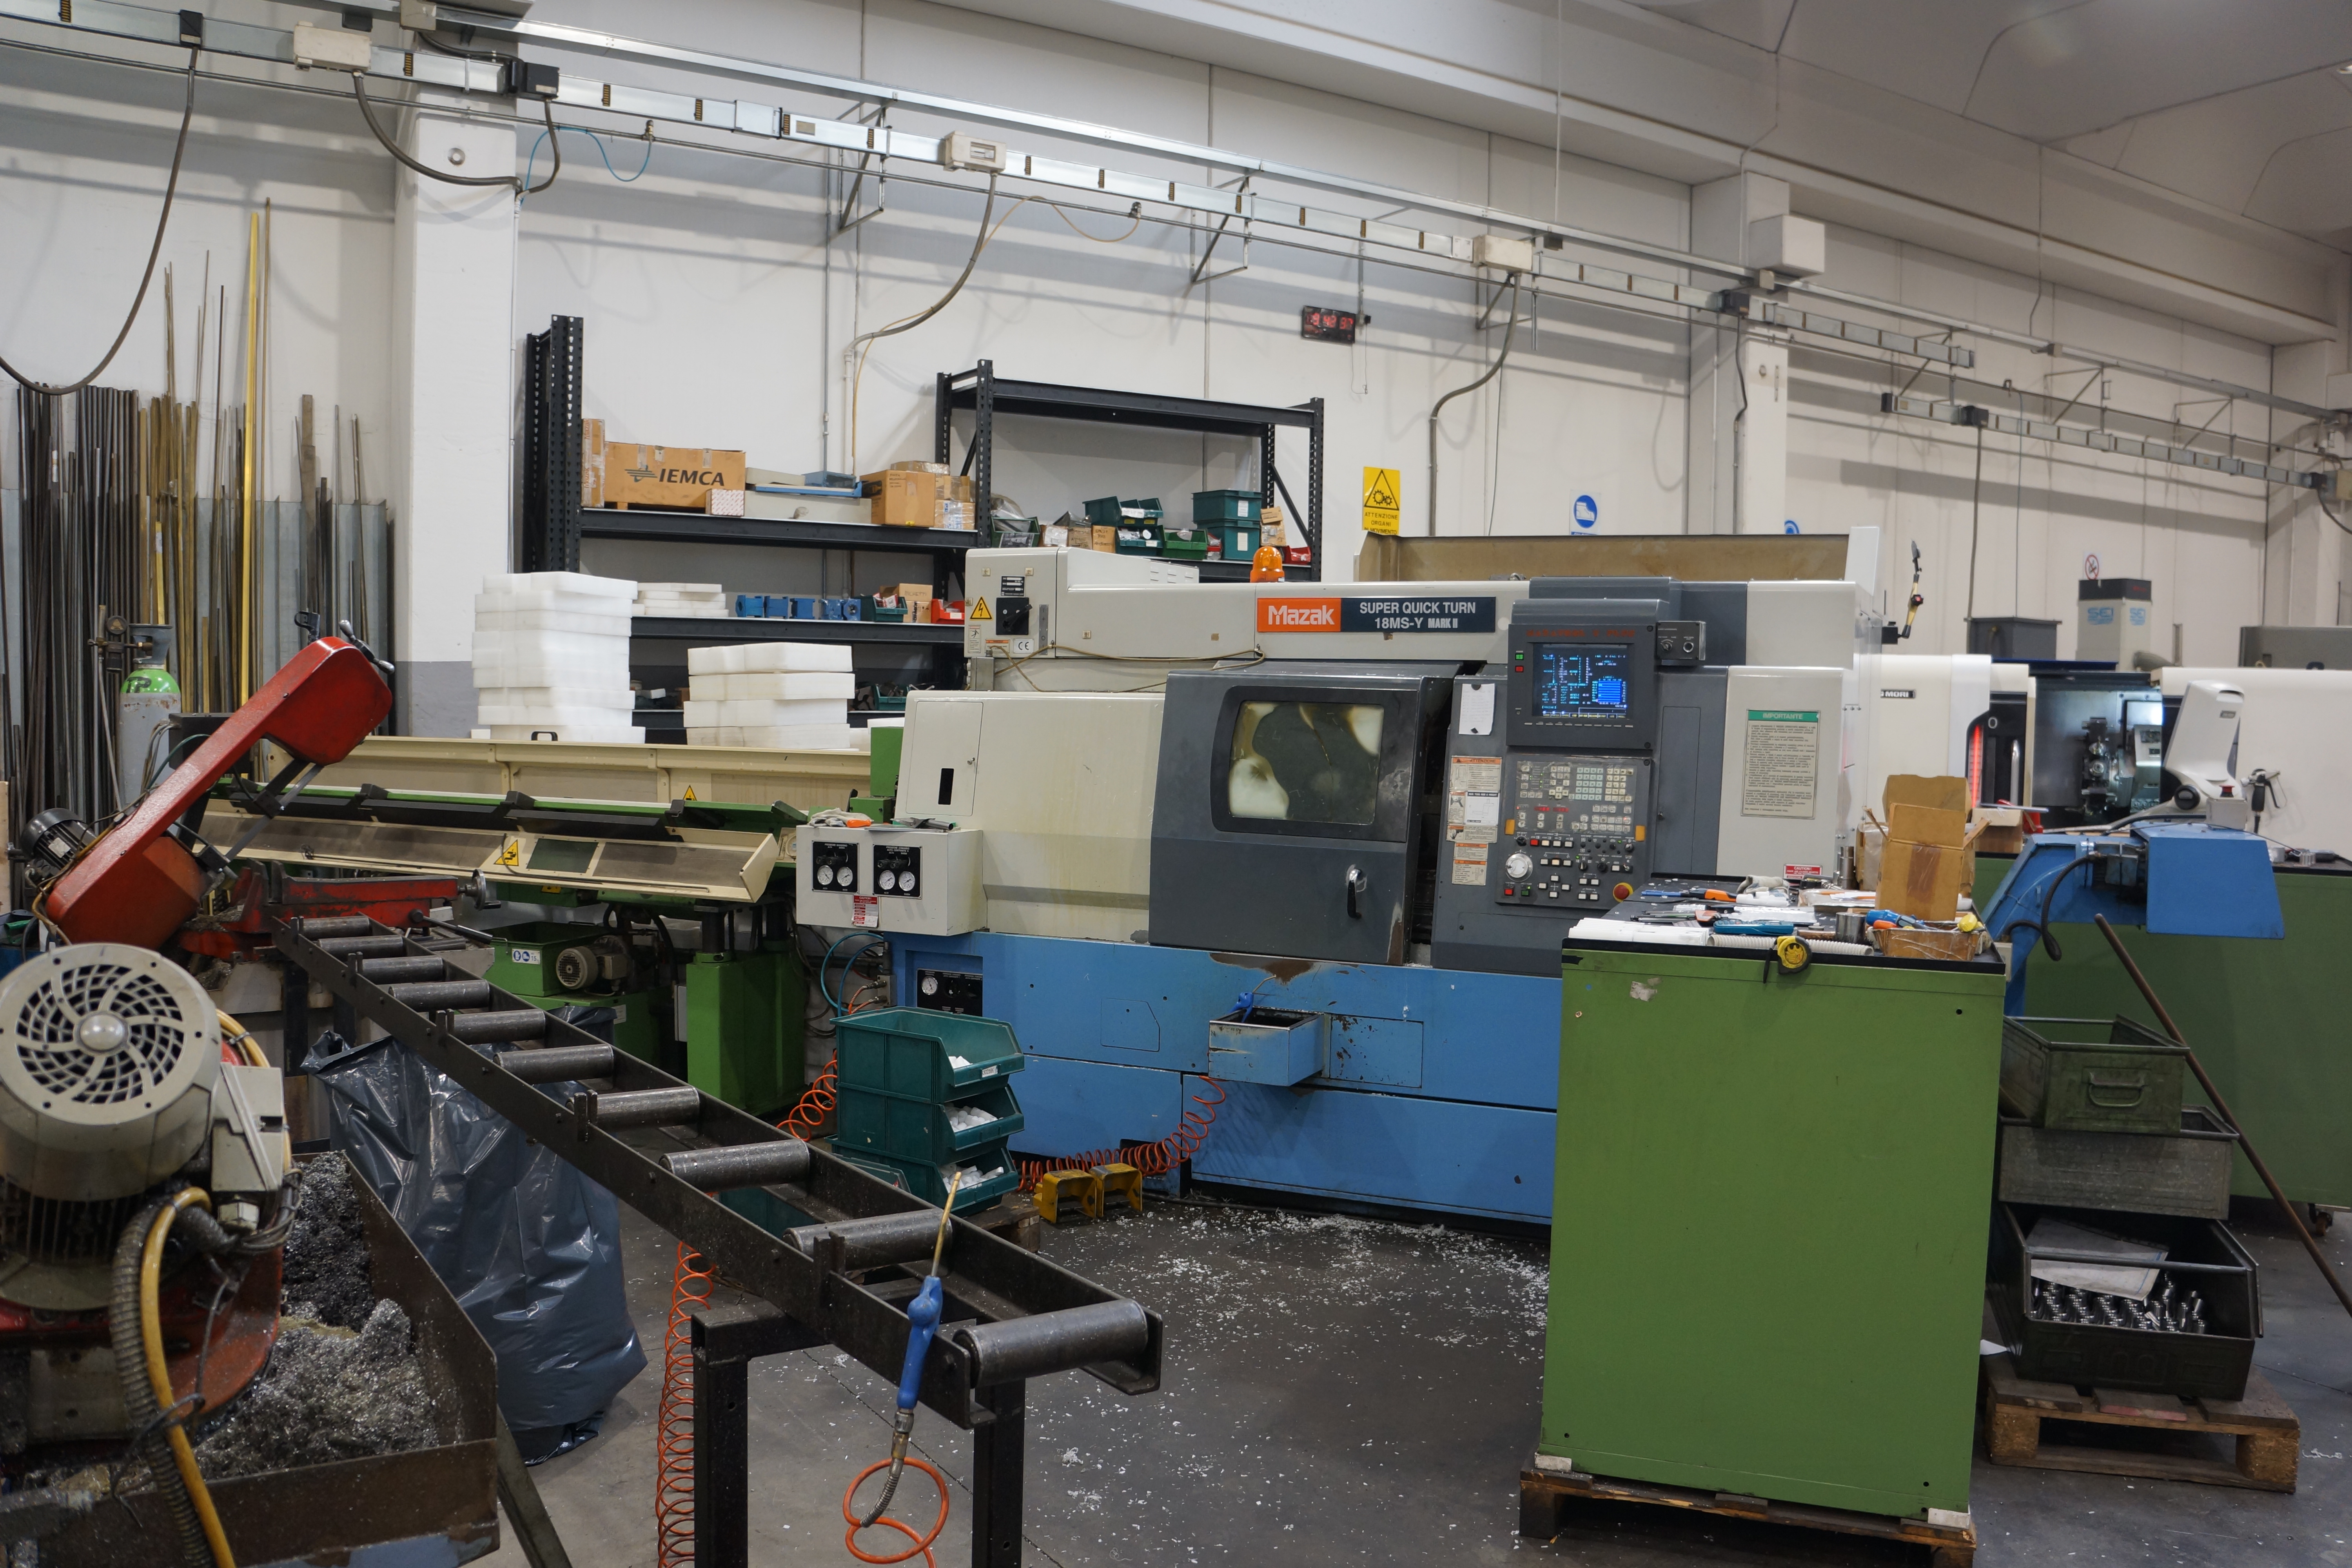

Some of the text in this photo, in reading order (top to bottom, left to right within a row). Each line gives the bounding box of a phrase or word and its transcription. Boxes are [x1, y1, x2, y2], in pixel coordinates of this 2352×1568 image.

[659, 468, 724, 486] IEMCA
[1268, 602, 1476, 625] Mazak SUPER QUICK TURN
[1375, 617, 1423, 629] 18MS-Y
[1428, 618, 1451, 628] MARK
